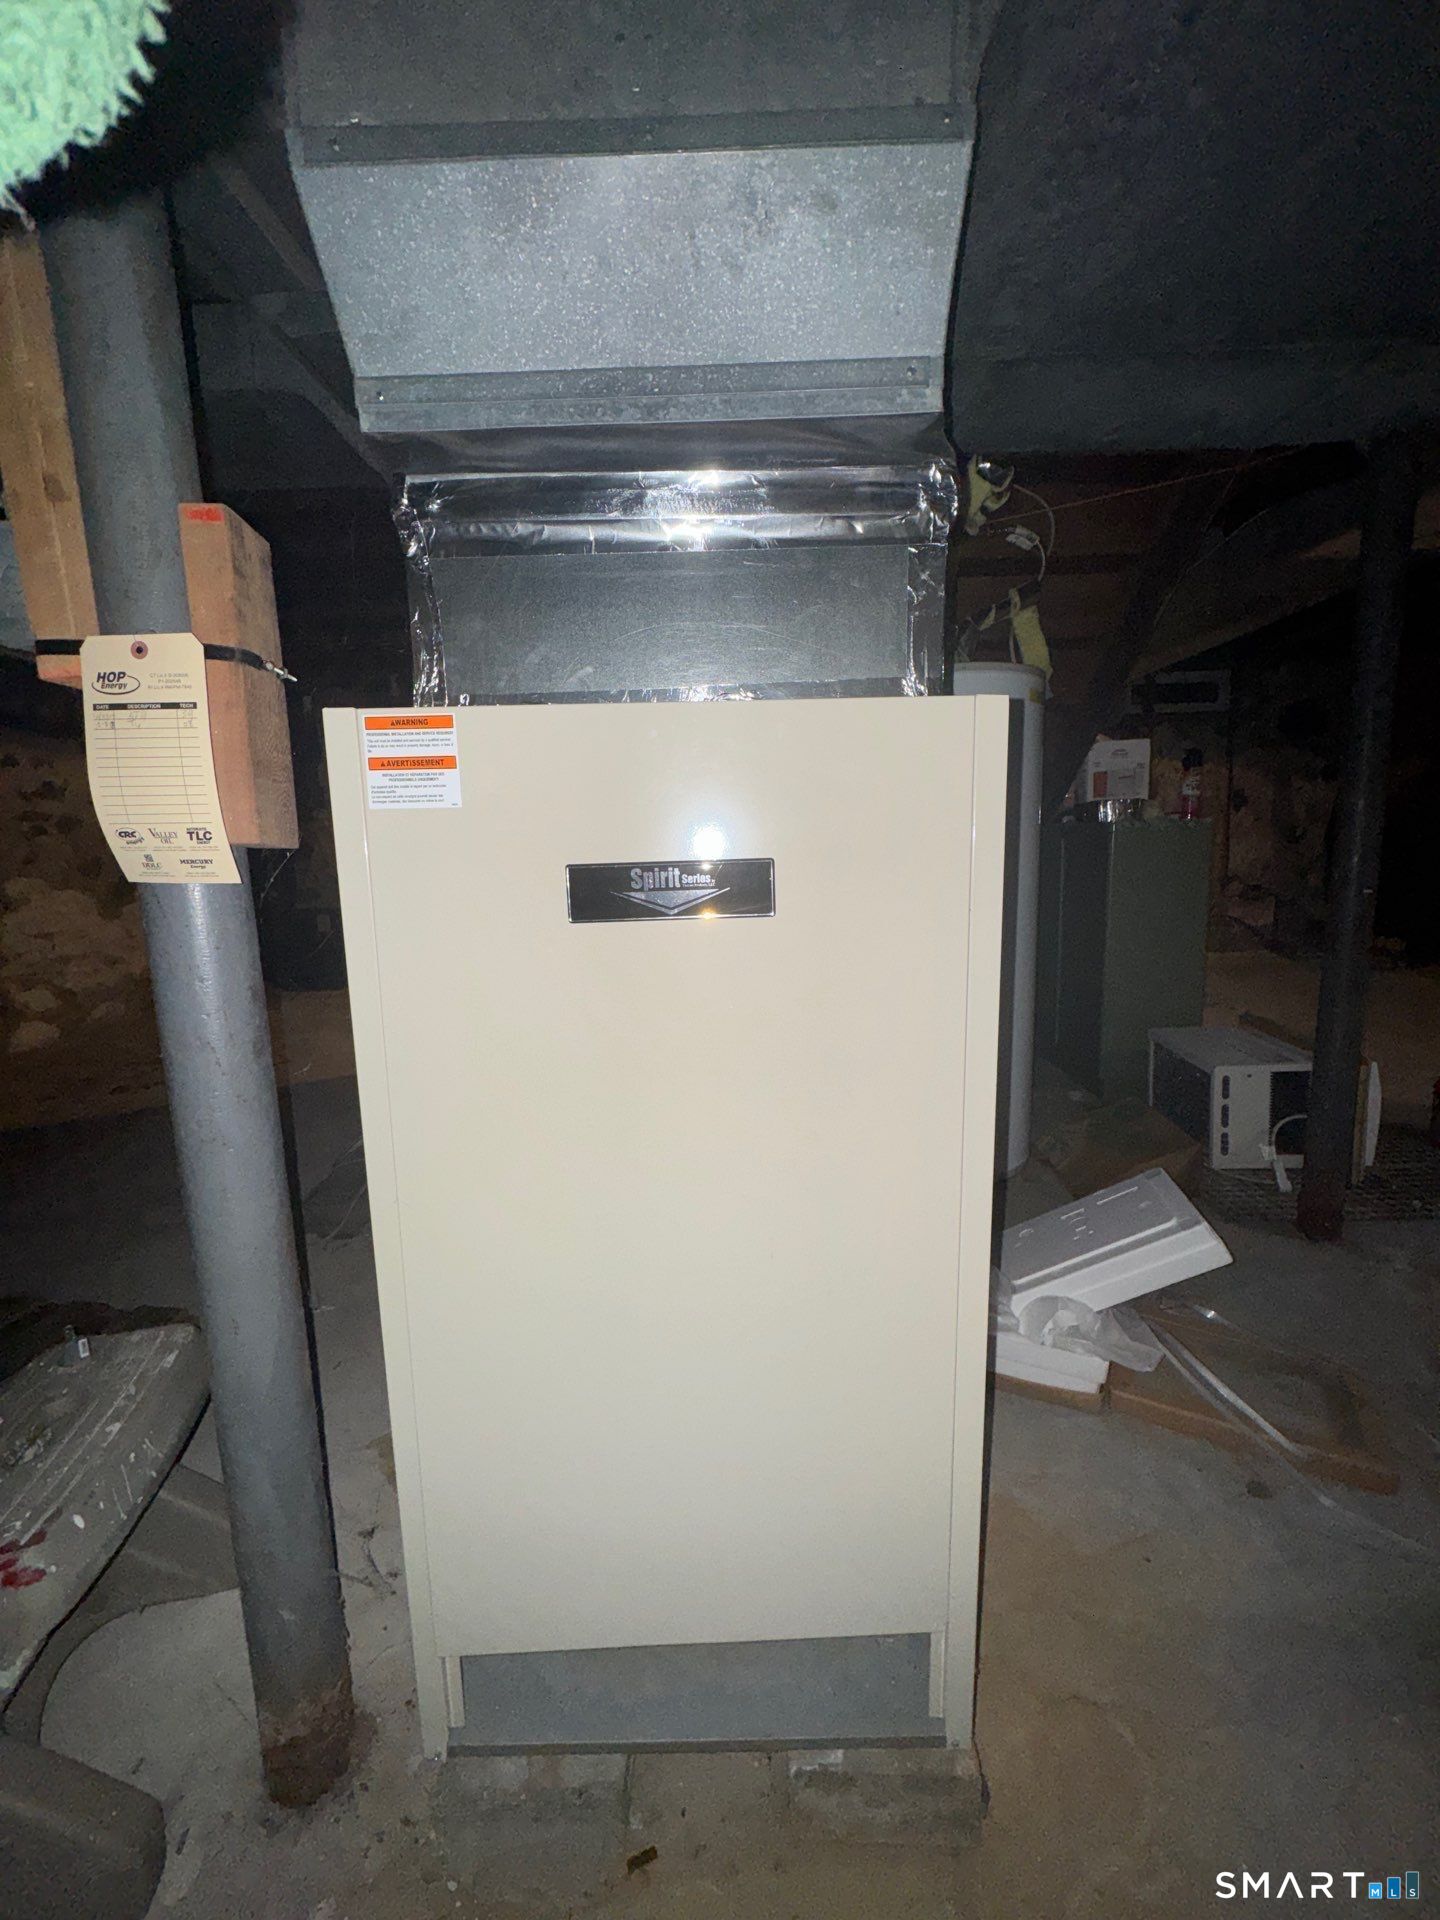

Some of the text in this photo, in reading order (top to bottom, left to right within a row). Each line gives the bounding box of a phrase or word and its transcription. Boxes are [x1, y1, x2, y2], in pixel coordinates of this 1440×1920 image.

[97, 671, 127, 683] HOP
[394, 718, 429, 726] WARNING
[386, 759, 445, 767] AVERTISSEMENT
[118, 831, 137, 839] CRC
[187, 831, 212, 841] TLC
[631, 867, 680, 891] Spirit
[681, 873, 711, 884] Series
